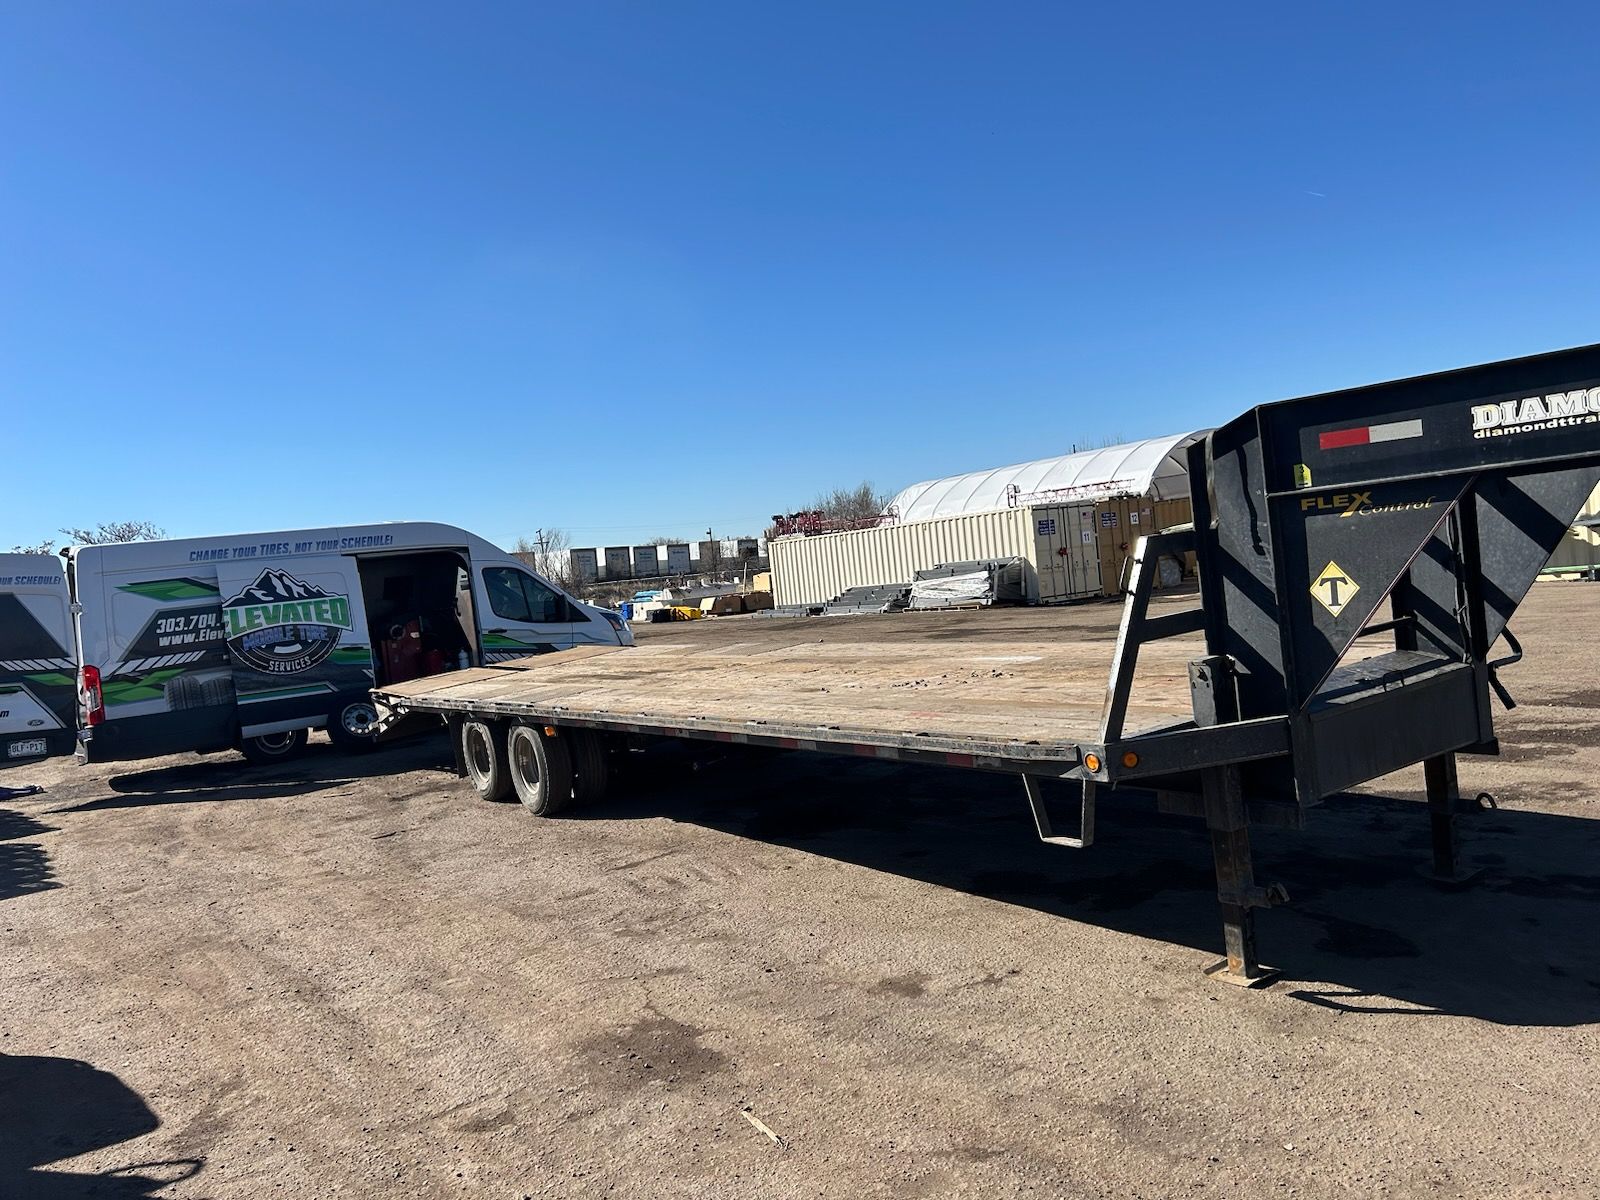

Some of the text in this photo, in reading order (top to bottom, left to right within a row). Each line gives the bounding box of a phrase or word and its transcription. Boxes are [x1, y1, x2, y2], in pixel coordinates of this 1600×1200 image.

[1301, 491, 1437, 518] FLEX Control
[1131, 514, 1138, 523] 12
[1083, 533, 1090, 542] 11
[189, 535, 394, 562] CHANGE YOUR TIRES, NOT YOUR SCHEDULE!
[14, 576, 61, 585] SCHEDULE!
[1319, 576, 1348, 606] T
[156, 613, 224, 634] 303.704.
[242, 625, 328, 651] MOBILE TIRE
[268, 656, 312, 672] SERVICES
